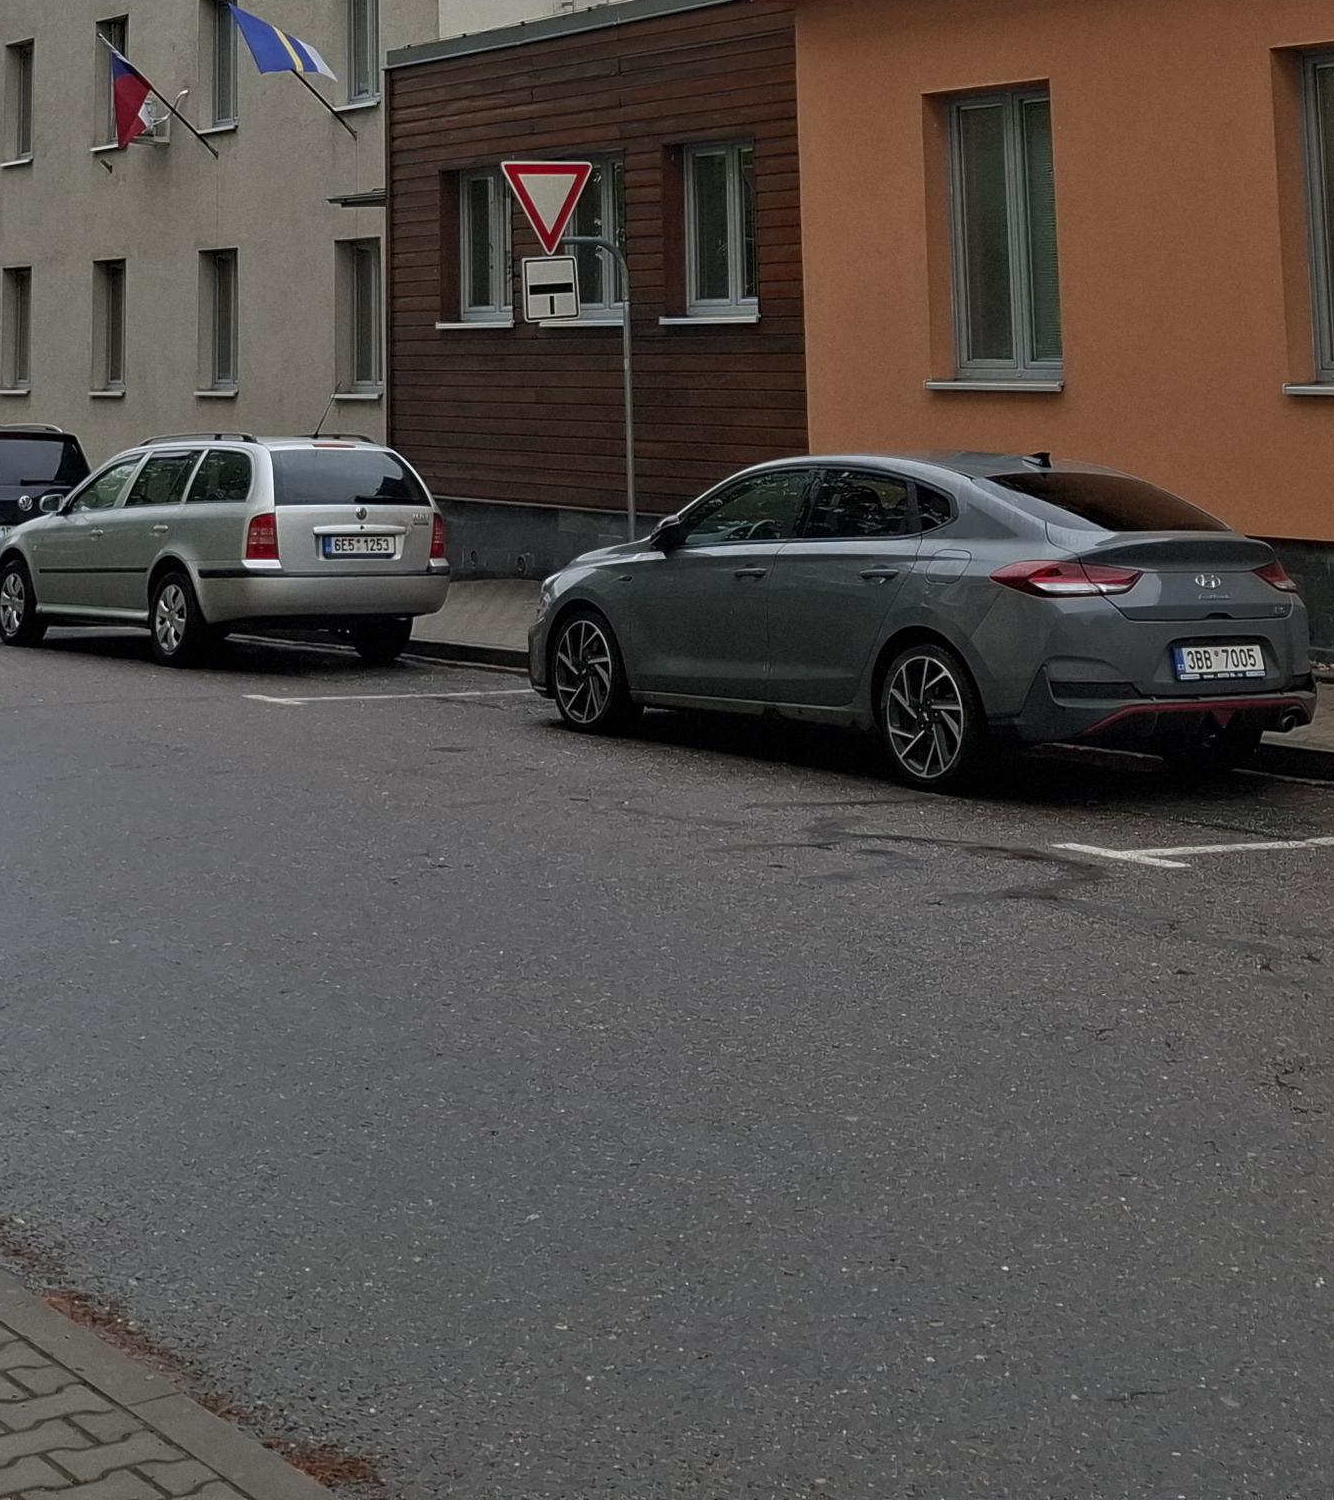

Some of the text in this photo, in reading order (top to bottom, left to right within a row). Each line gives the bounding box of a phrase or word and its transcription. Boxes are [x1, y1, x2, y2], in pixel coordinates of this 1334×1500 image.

[363, 538, 389, 552] 1253
[1186, 648, 1257, 670] 3BB 7005
